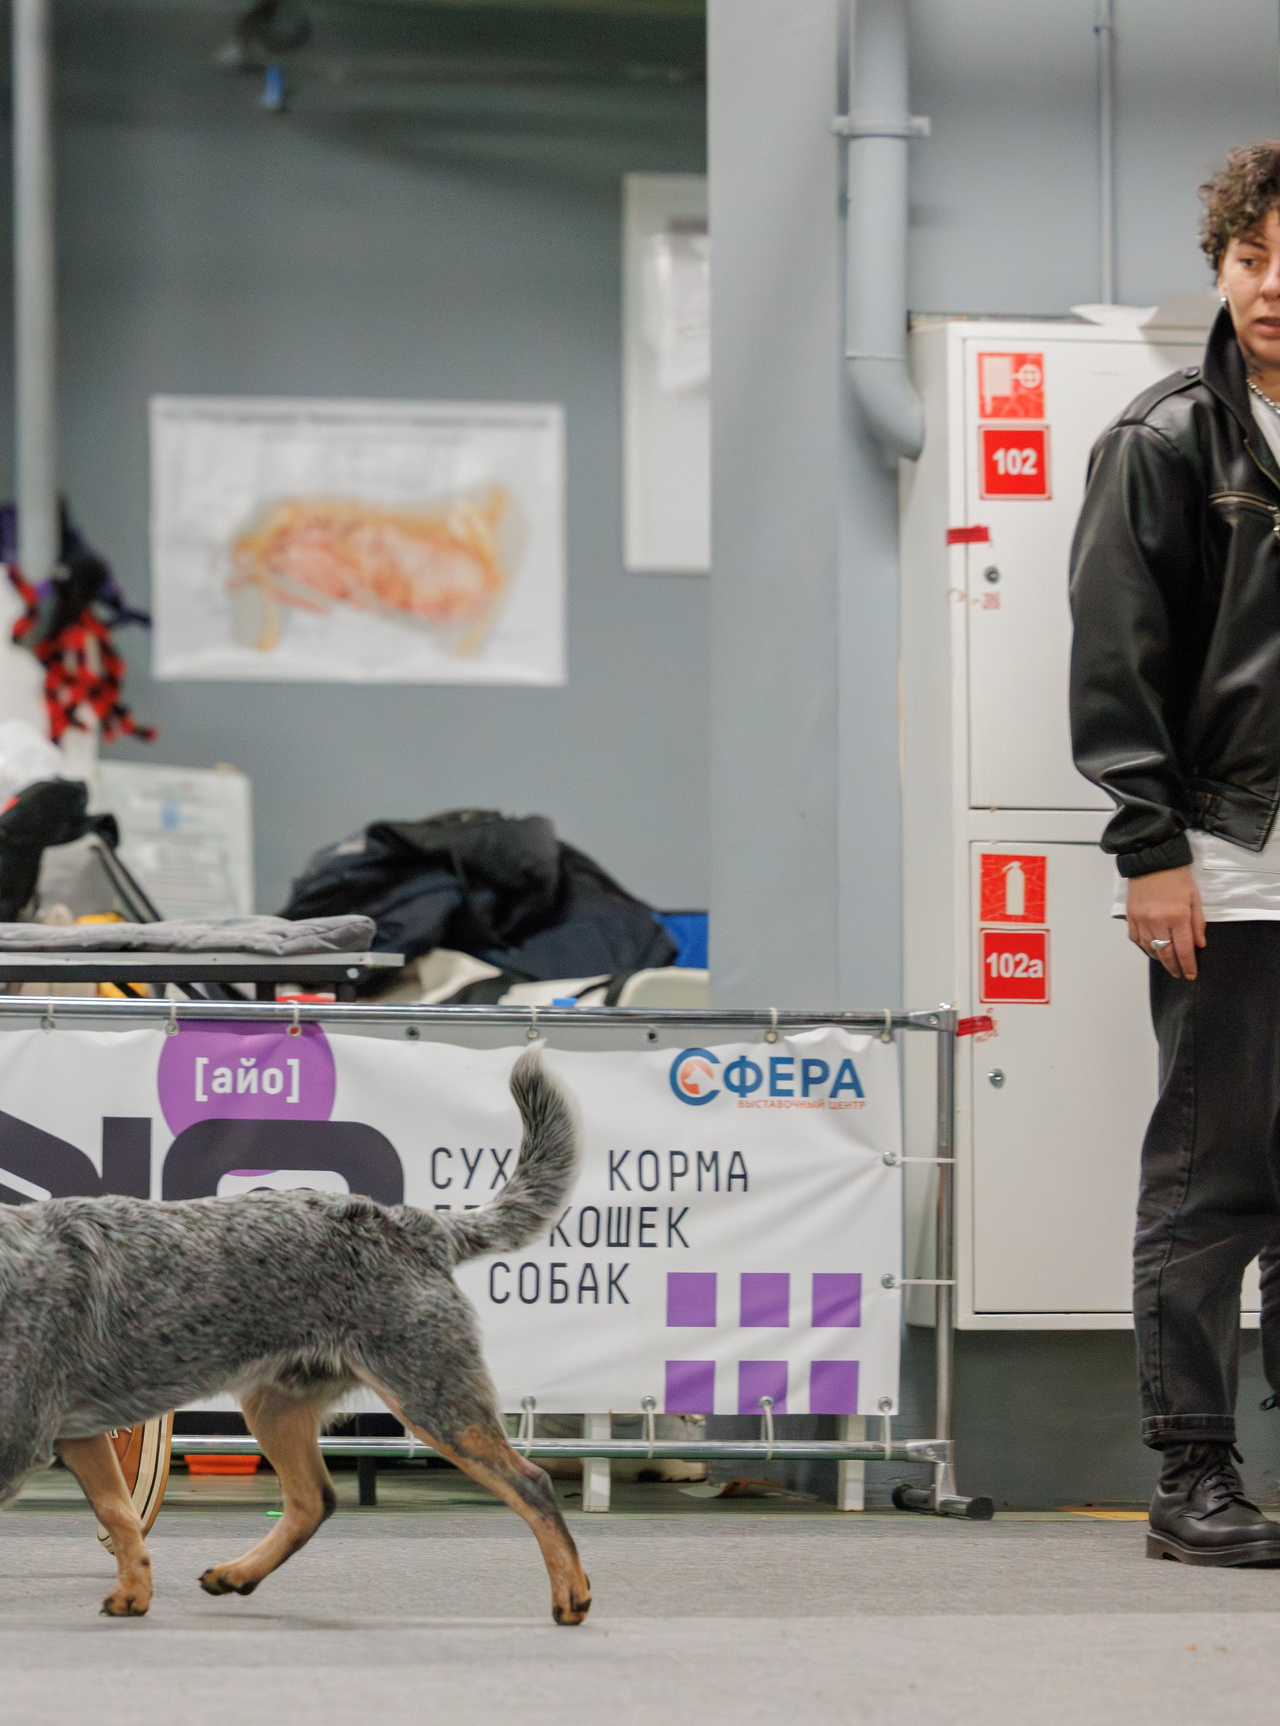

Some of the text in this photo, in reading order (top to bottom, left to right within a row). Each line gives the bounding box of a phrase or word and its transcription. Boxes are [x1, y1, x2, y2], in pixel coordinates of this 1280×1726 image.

[992, 447, 1038, 475] 102
[195, 1057, 300, 1103] [айо]
[669, 1047, 866, 1106] СФЕРА
[431, 1147, 513, 1190] СУХ
[608, 1149, 749, 1193] КОРМА
[549, 1205, 690, 1248] КОШЕК
[489, 1261, 631, 1305] СОБАК
